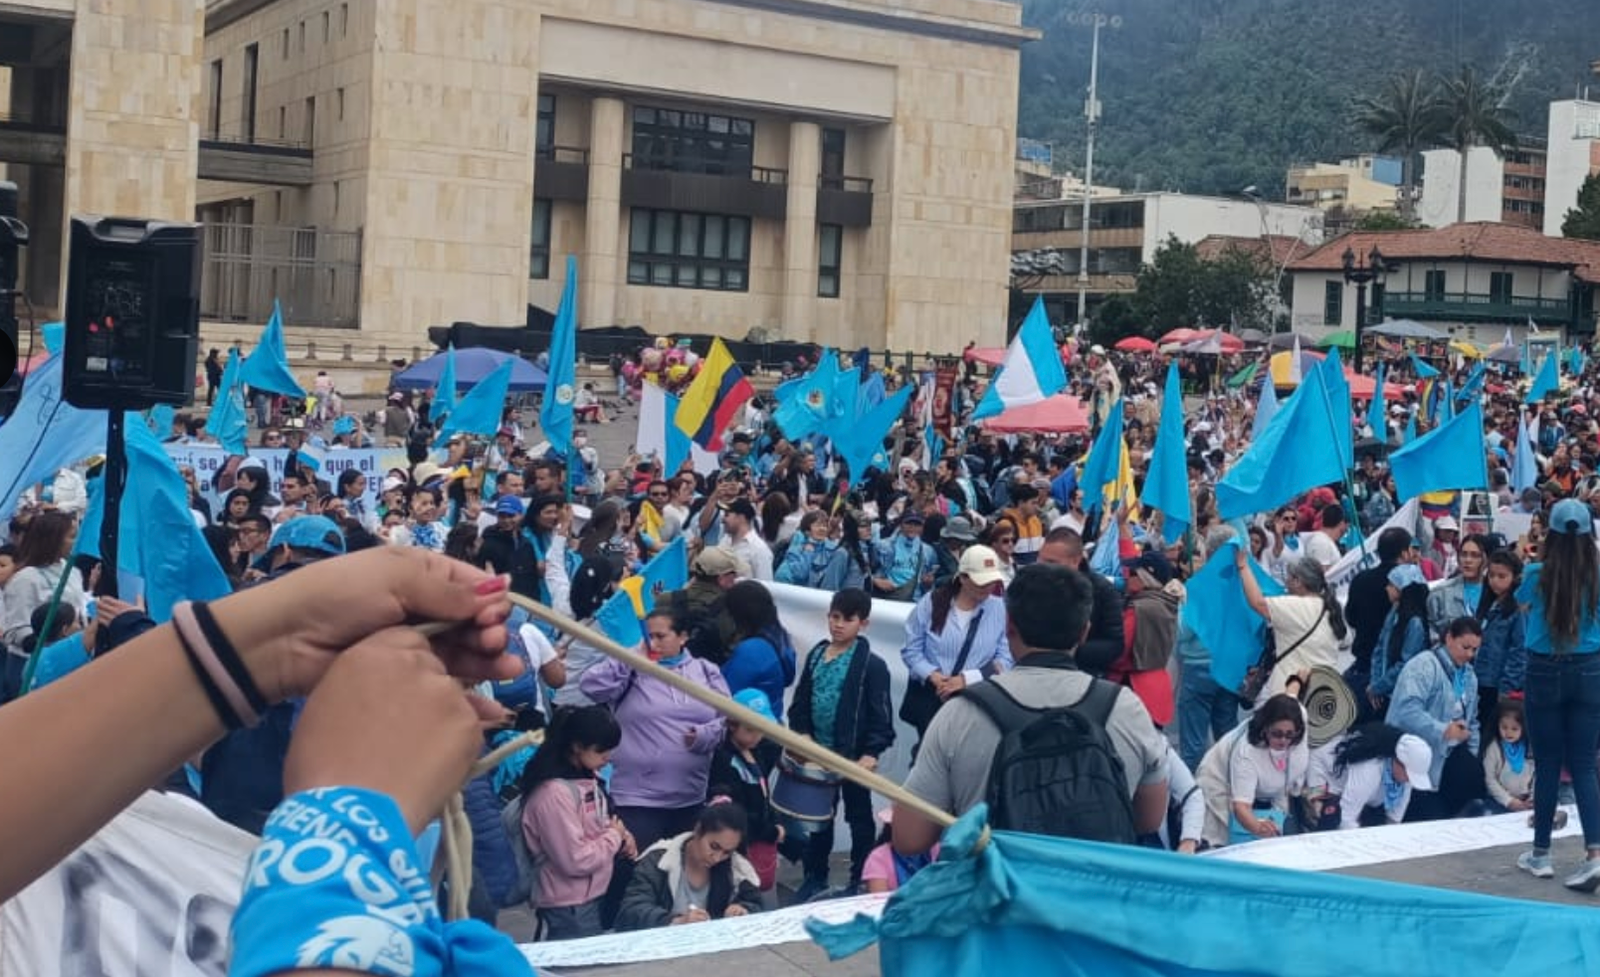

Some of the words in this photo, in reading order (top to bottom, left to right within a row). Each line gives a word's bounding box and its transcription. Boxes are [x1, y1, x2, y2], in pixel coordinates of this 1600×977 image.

[198, 457, 218, 471] se
[325, 459, 354, 476] que
[359, 455, 375, 471] el
[331, 795, 390, 844] LOS
